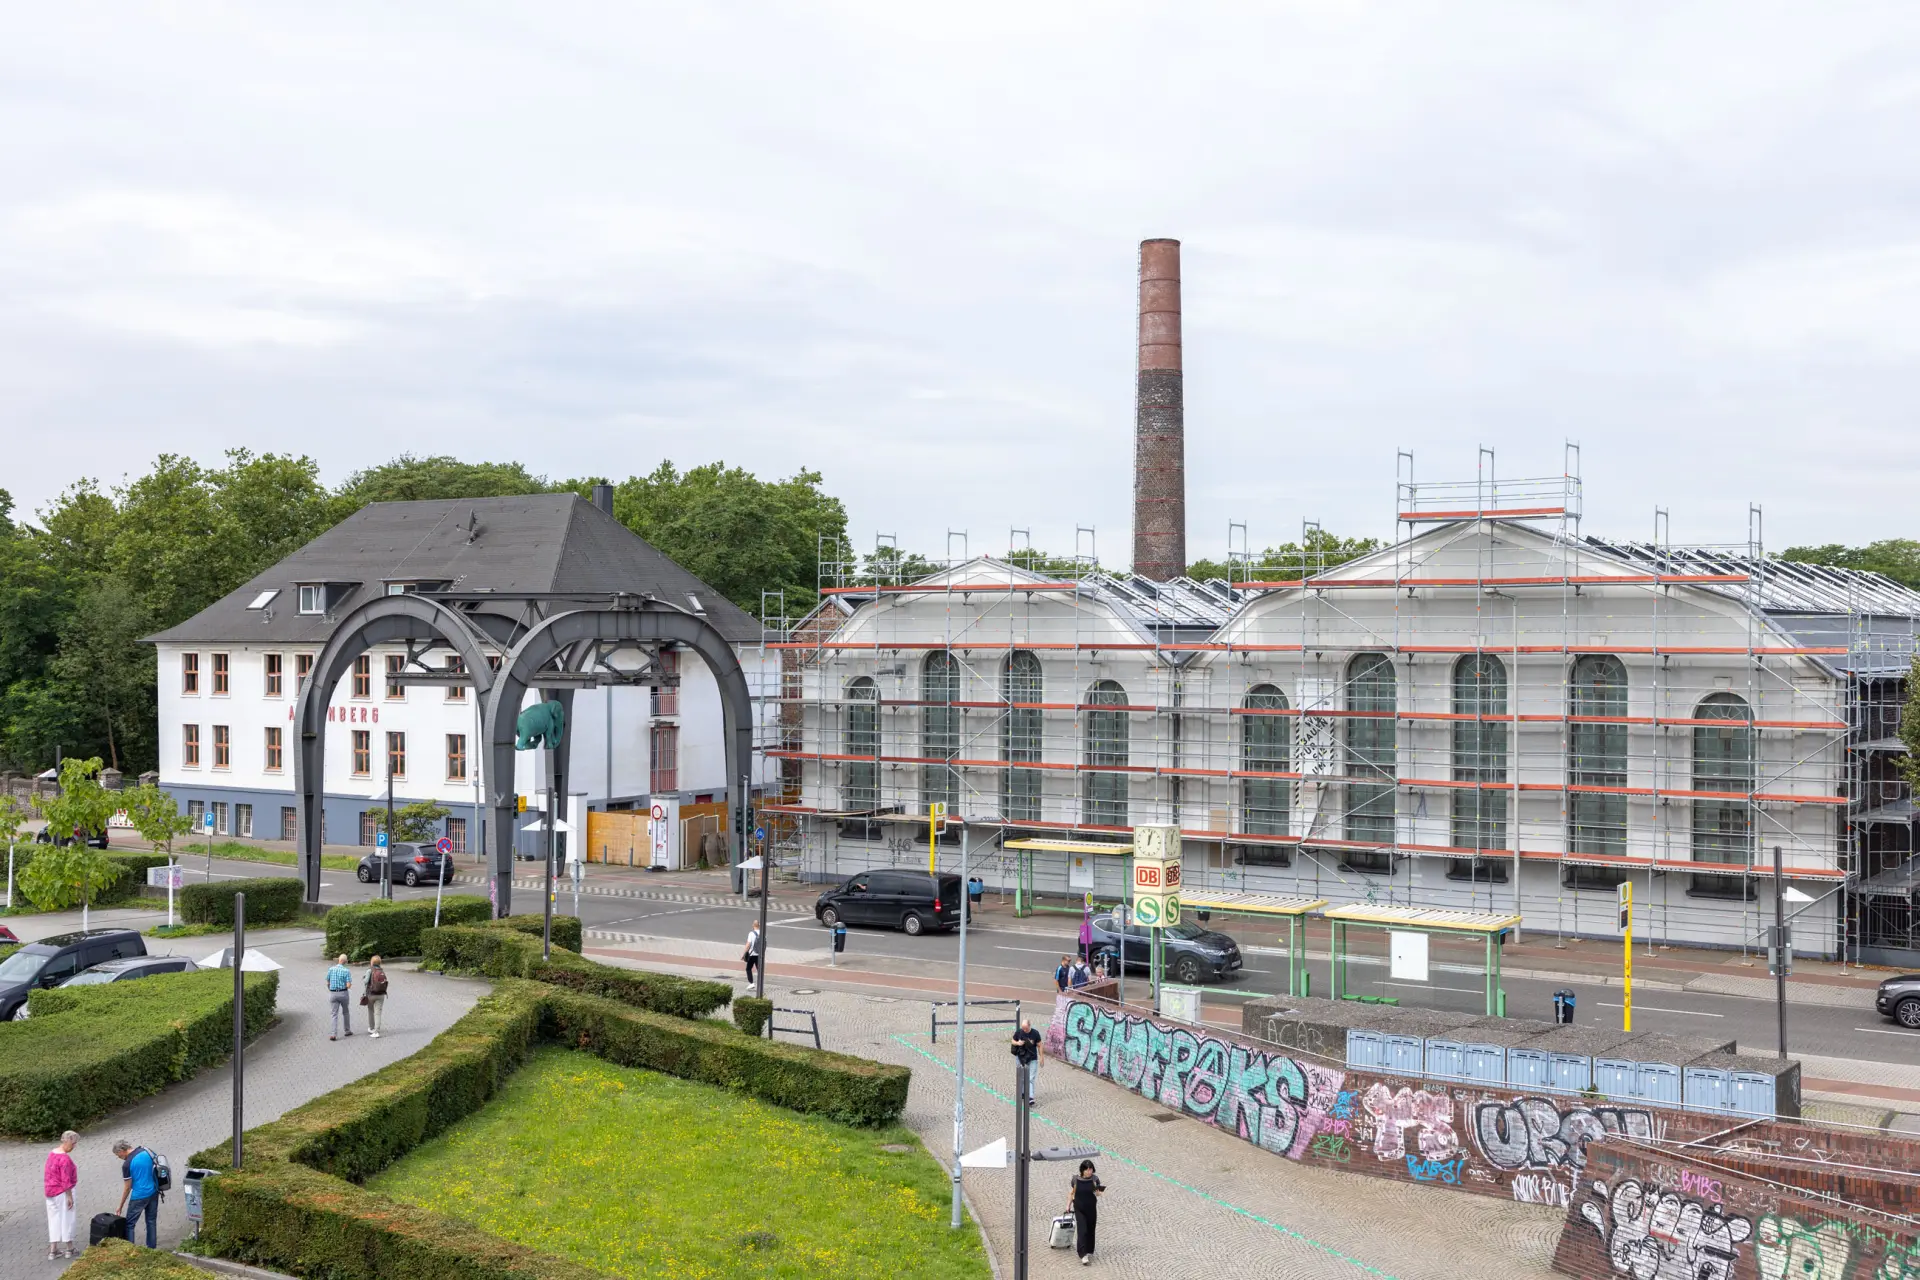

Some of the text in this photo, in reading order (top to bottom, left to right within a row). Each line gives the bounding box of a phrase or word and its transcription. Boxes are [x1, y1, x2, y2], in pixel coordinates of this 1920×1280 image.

[288, 704, 379, 724] ANBERG
[378, 834, 386, 846] P
[1139, 868, 1158, 884] DB
[1681, 1168, 1724, 1204] BMBS
